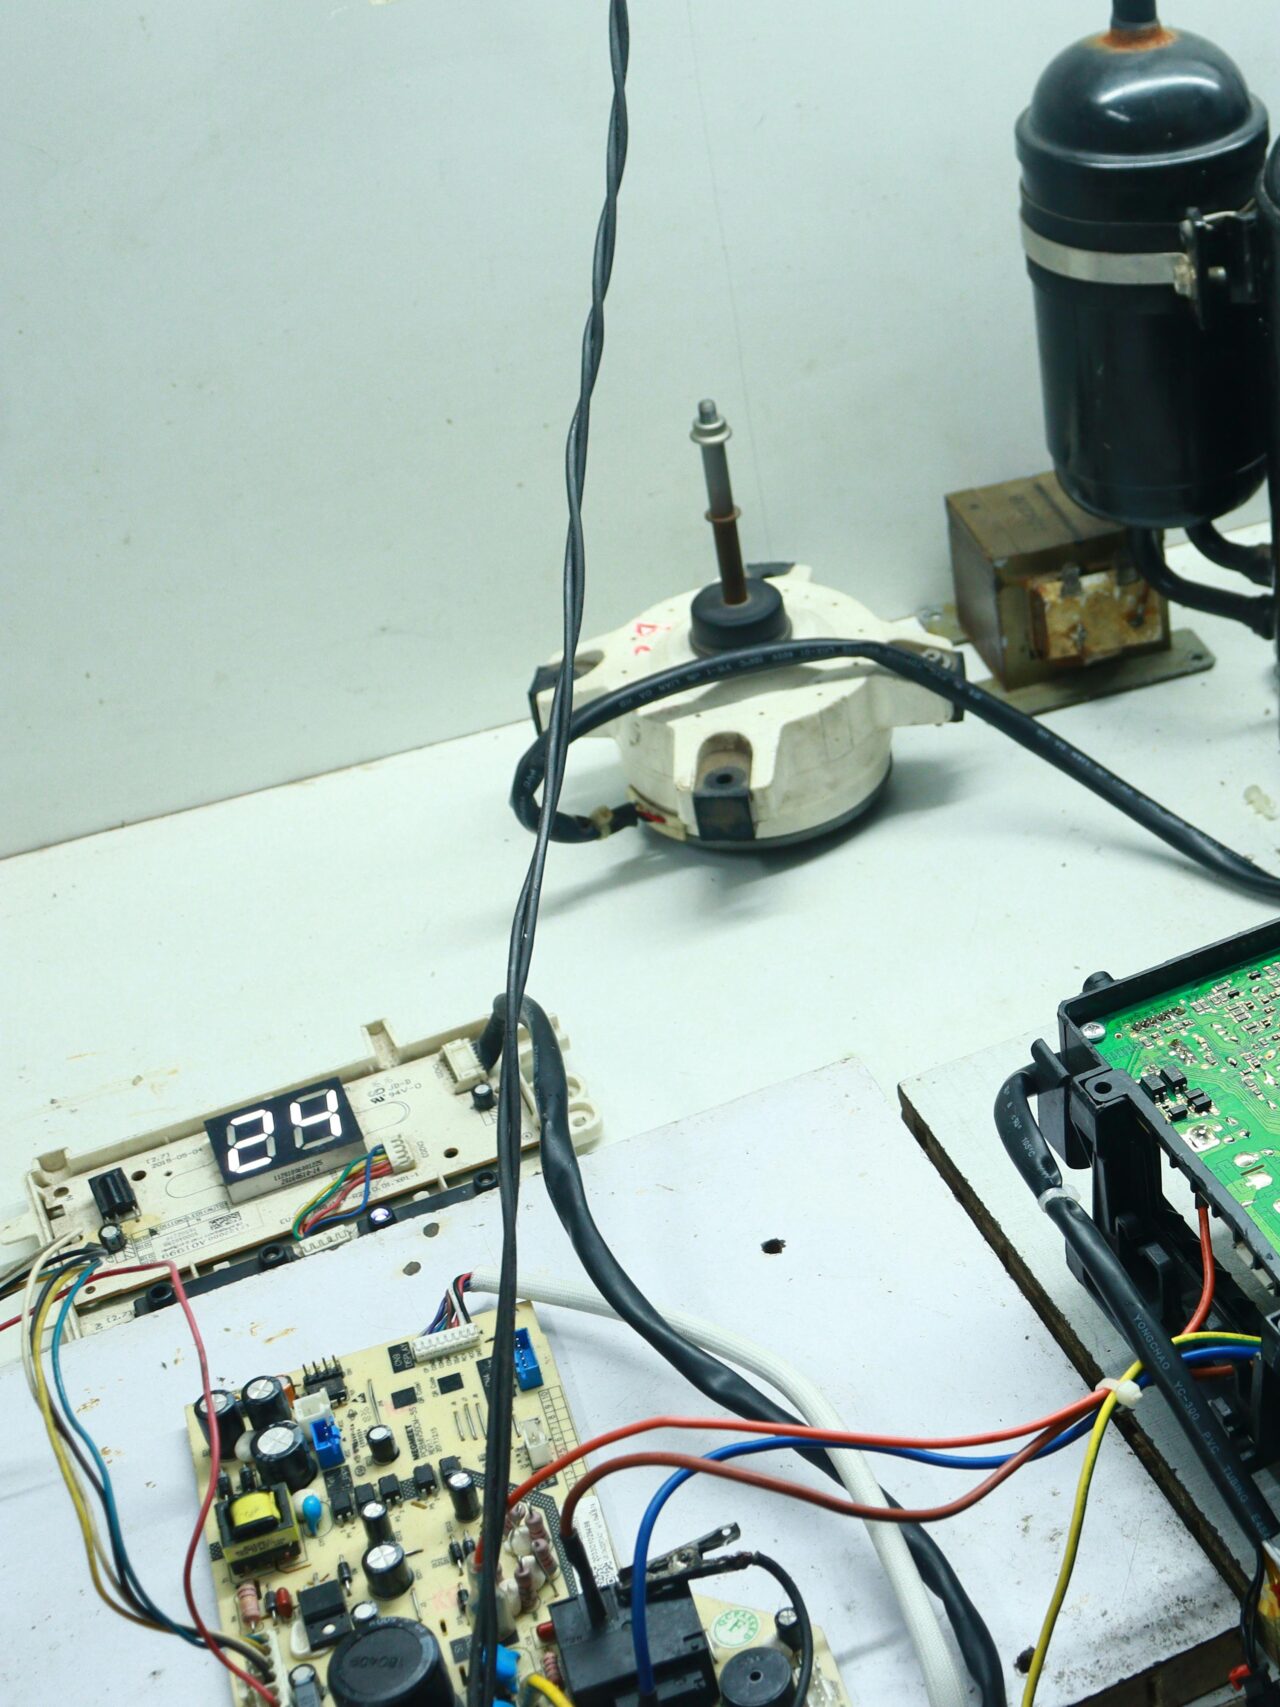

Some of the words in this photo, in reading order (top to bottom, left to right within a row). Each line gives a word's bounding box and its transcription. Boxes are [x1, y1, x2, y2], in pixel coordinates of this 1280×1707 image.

[227, 1089, 342, 1174] 24
[1132, 1312, 1170, 1371] YONGCHAO
[1171, 1380, 1201, 1420] YC-300
[1201, 1431, 1220, 1454] PVC
[1220, 1464, 1250, 1504] TUBING
